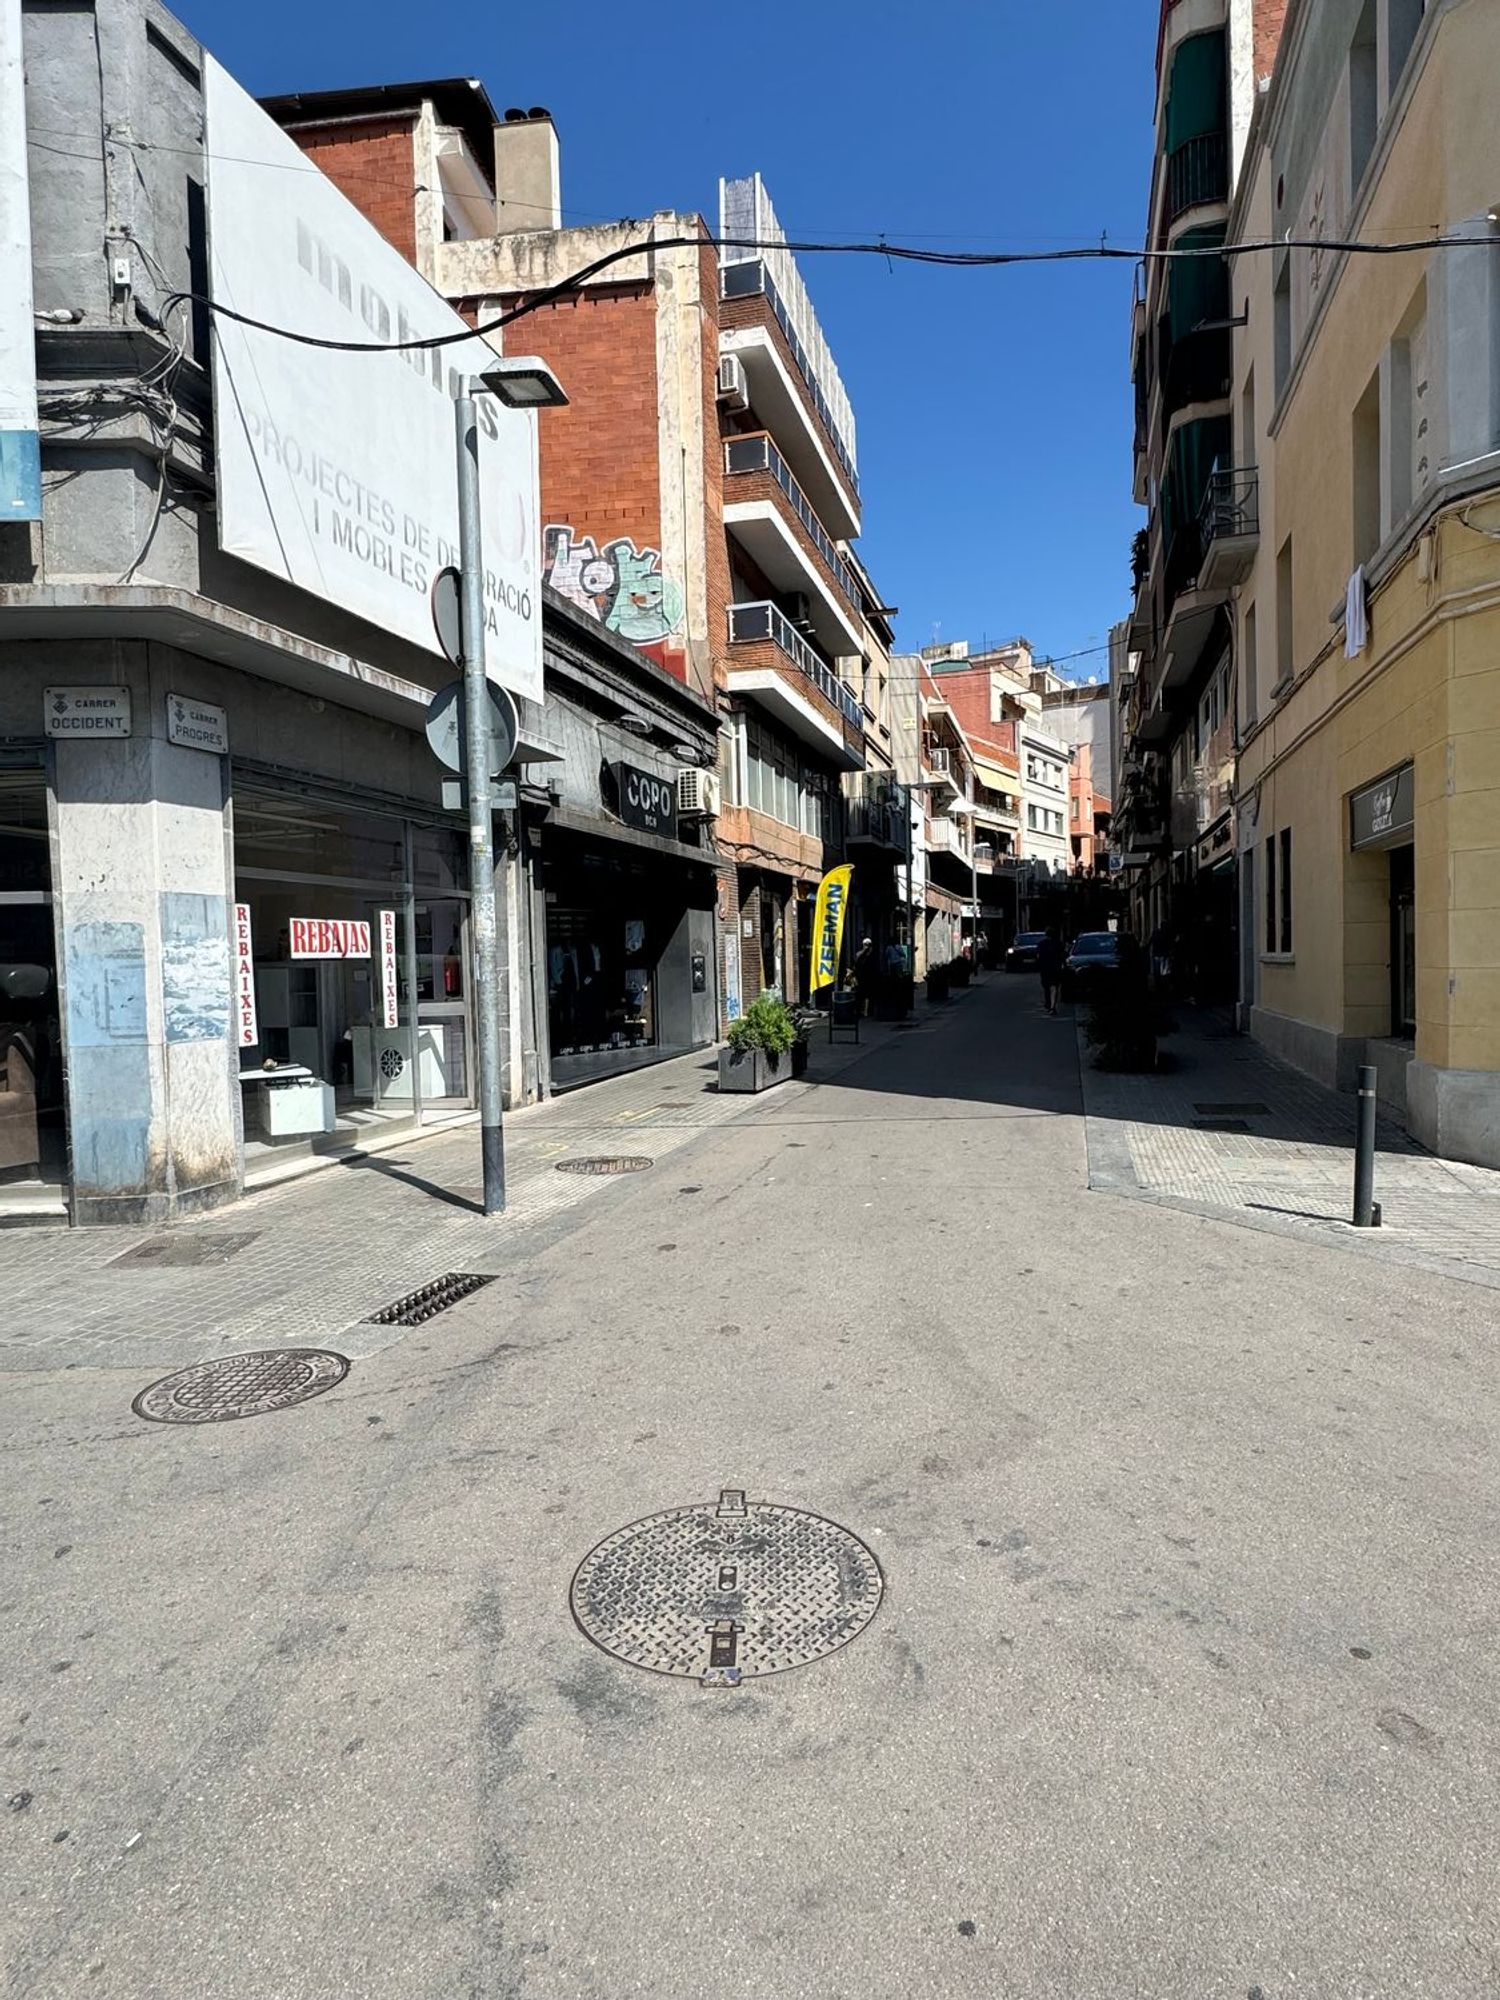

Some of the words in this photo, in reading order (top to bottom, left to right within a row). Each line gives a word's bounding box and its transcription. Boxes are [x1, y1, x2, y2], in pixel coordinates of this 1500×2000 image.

[244, 404, 395, 537] PROJECTES
[403, 513, 431, 560] DE
[314, 497, 320, 535] I
[332, 509, 428, 596] MOBLES
[51, 717, 124, 730] OCCIDENT
[75, 699, 116, 708] CARRER
[189, 711, 218, 725] CARRER
[627, 773, 671, 817] COPO
[292, 920, 369, 957] REBAJAS
[820, 883, 843, 977] ZEEMAN
[236, 906, 253, 1043] REBAIXES
[384, 913, 396, 1026] REBAIXES
